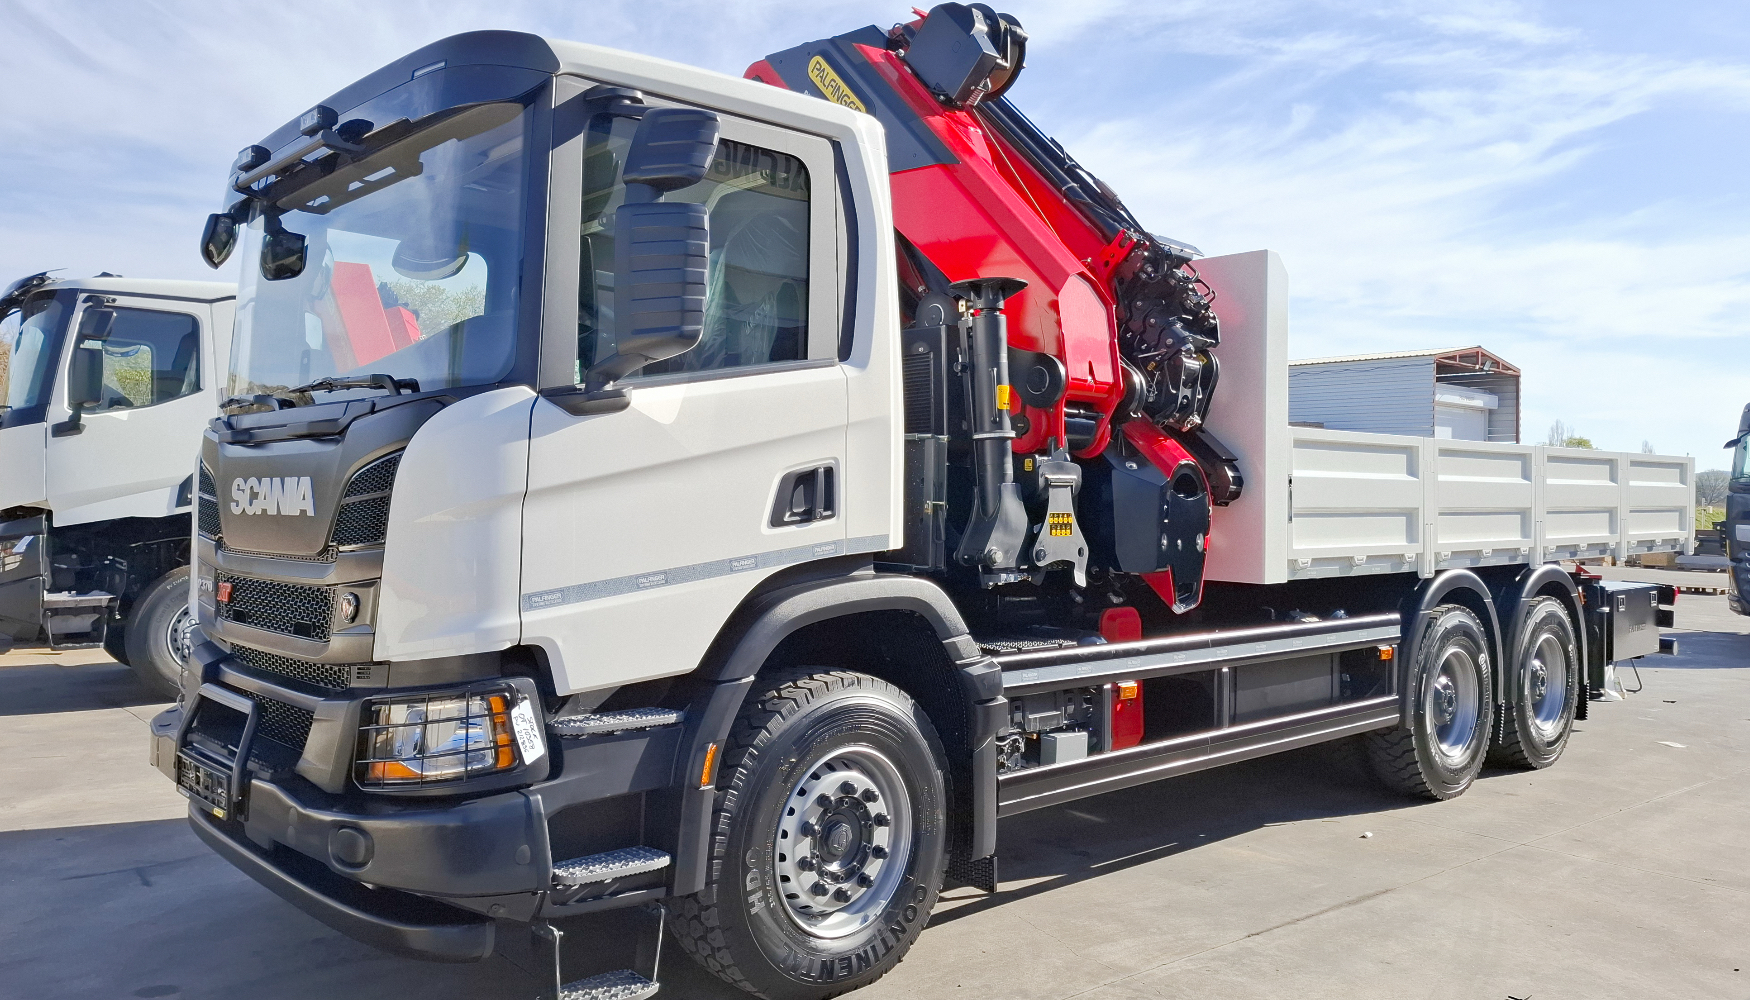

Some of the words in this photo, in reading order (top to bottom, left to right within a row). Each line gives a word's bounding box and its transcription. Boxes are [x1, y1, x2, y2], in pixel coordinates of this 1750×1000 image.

[811, 60, 862, 111] PALFING
[230, 476, 315, 517] SCANIA
[780, 883, 928, 982] CONTINENTAL
